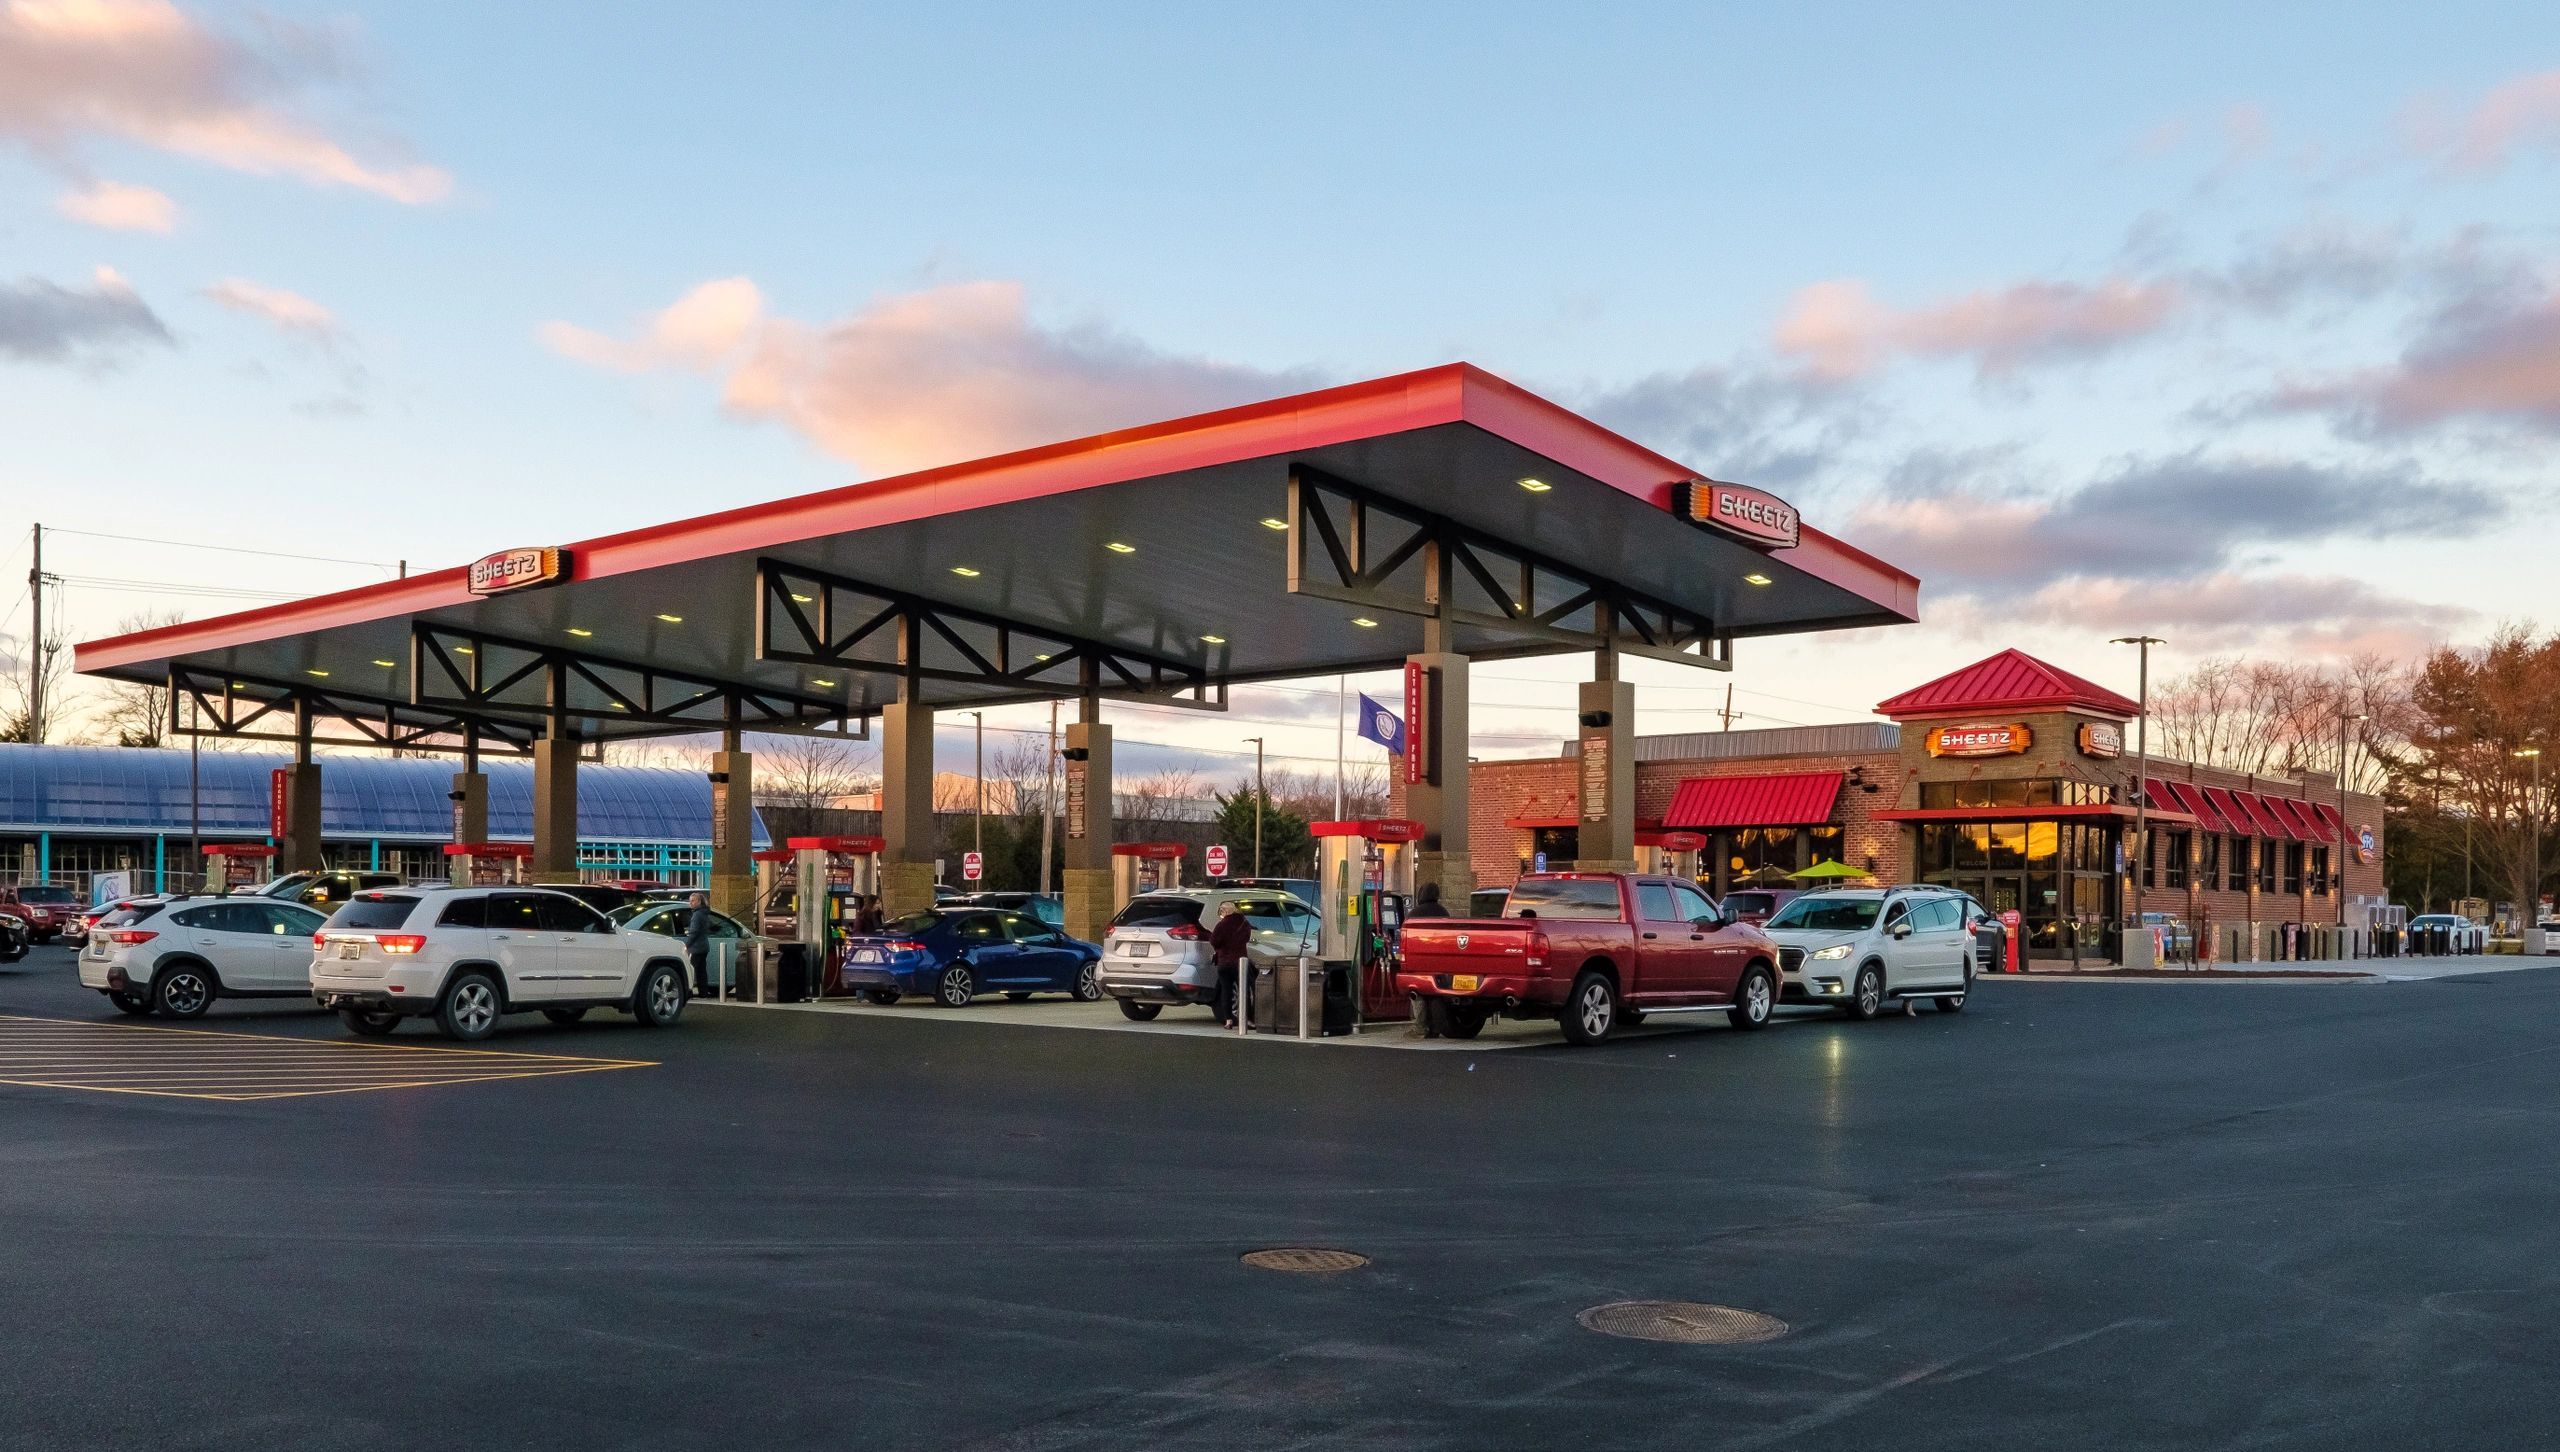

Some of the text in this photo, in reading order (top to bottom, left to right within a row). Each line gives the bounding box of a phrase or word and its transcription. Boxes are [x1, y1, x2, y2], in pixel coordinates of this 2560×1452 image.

[1720, 493, 1791, 532] SHEETZ
[476, 555, 535, 583] SHEETZ
[1941, 732, 2010, 746] SHEETZ
[2093, 732, 2120, 750] SHEETZ
